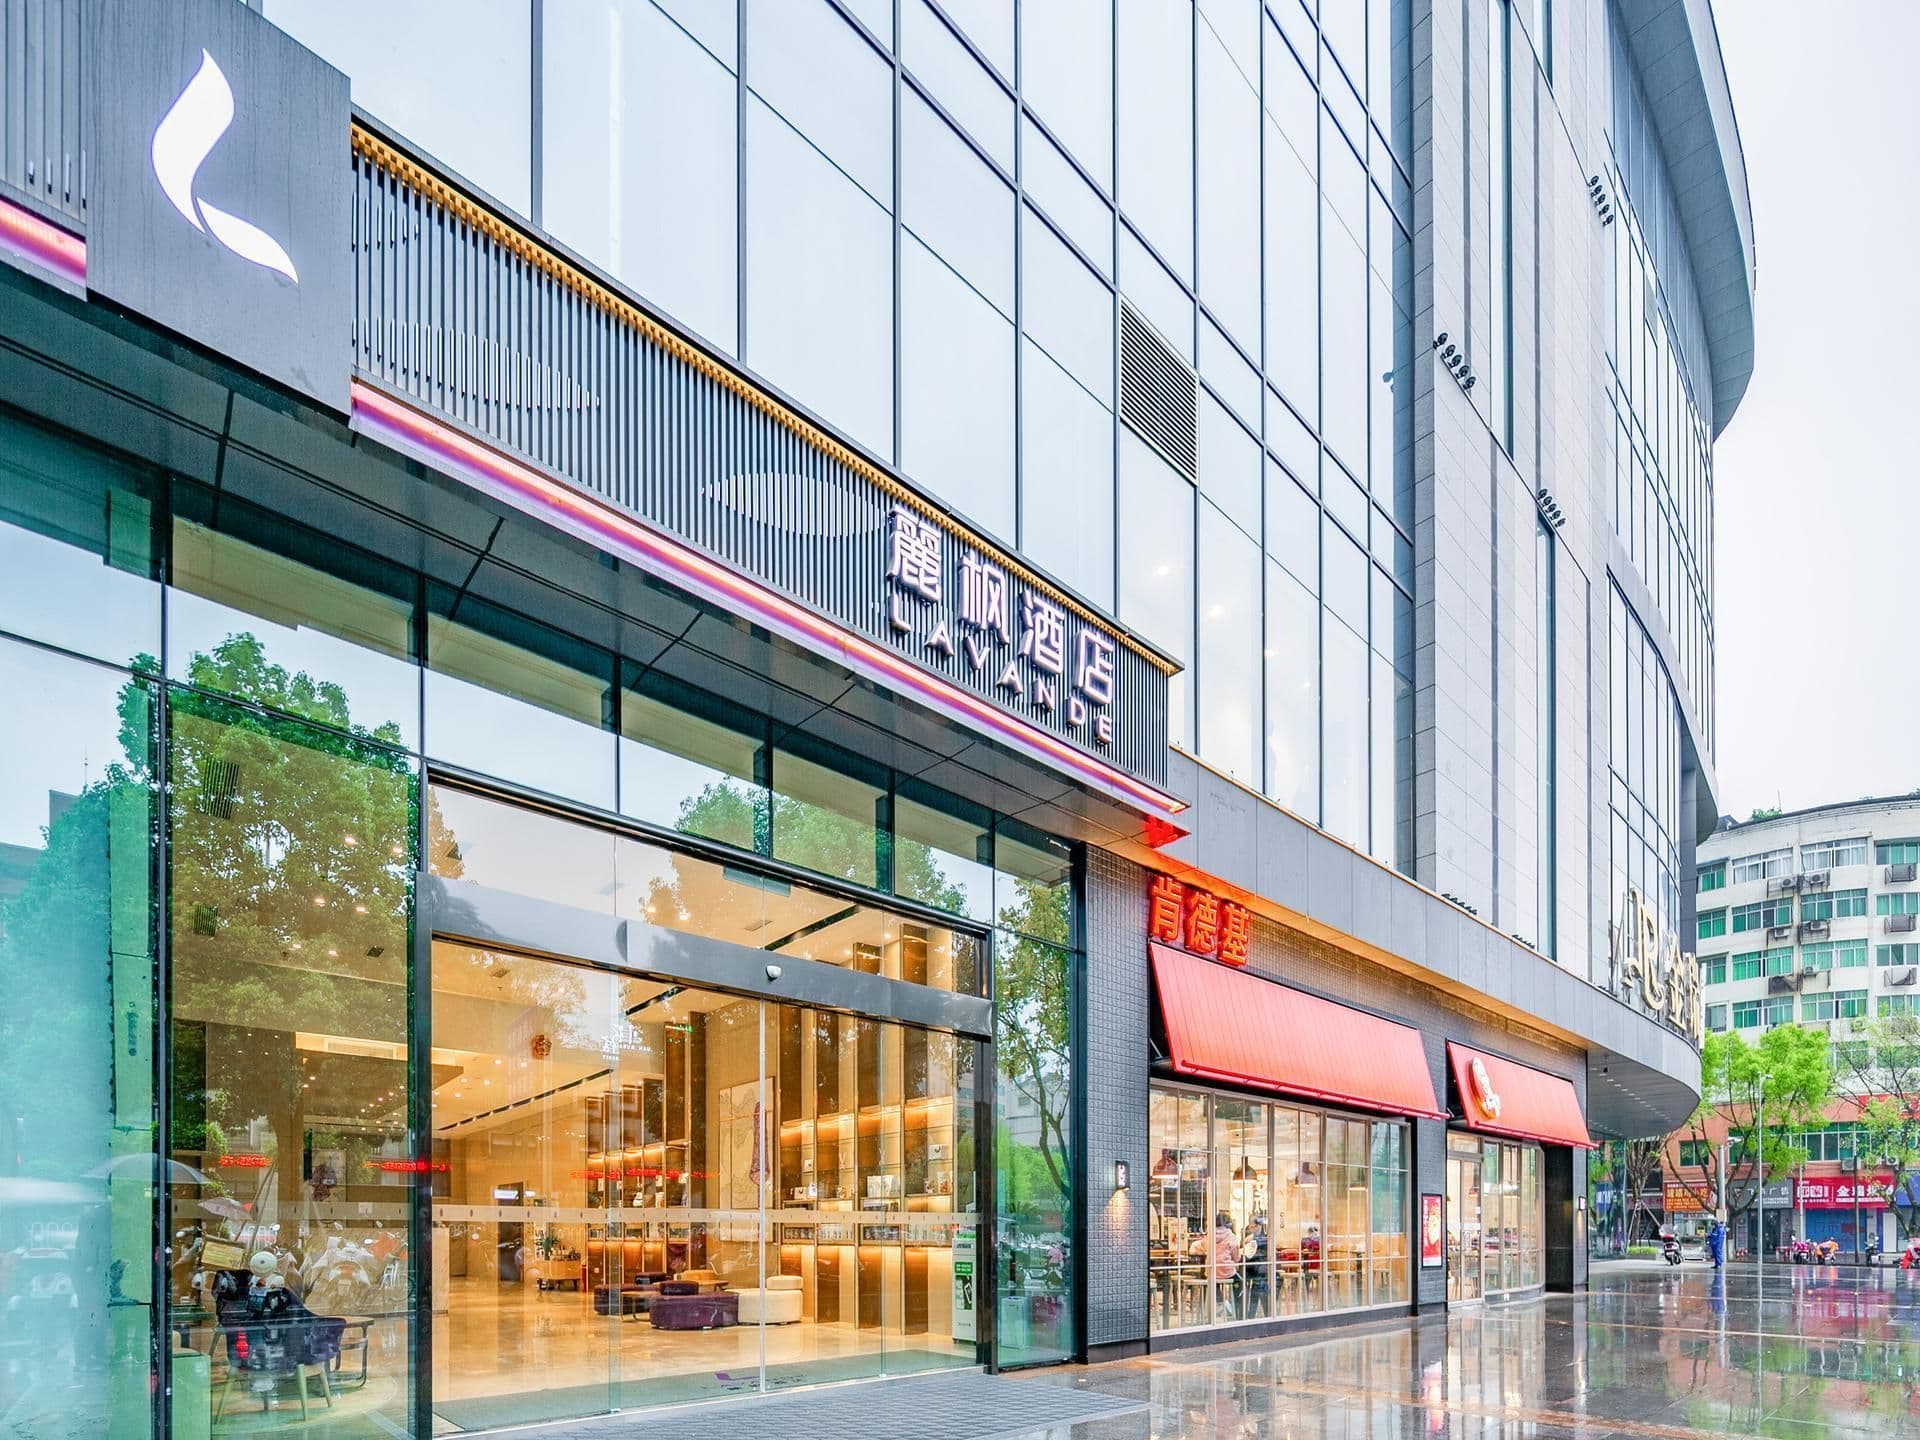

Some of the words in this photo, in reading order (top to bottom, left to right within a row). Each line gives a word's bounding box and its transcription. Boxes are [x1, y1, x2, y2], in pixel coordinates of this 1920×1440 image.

[888, 591, 1113, 744] LAVANDE
[1150, 873, 1249, 967] 肯德基
